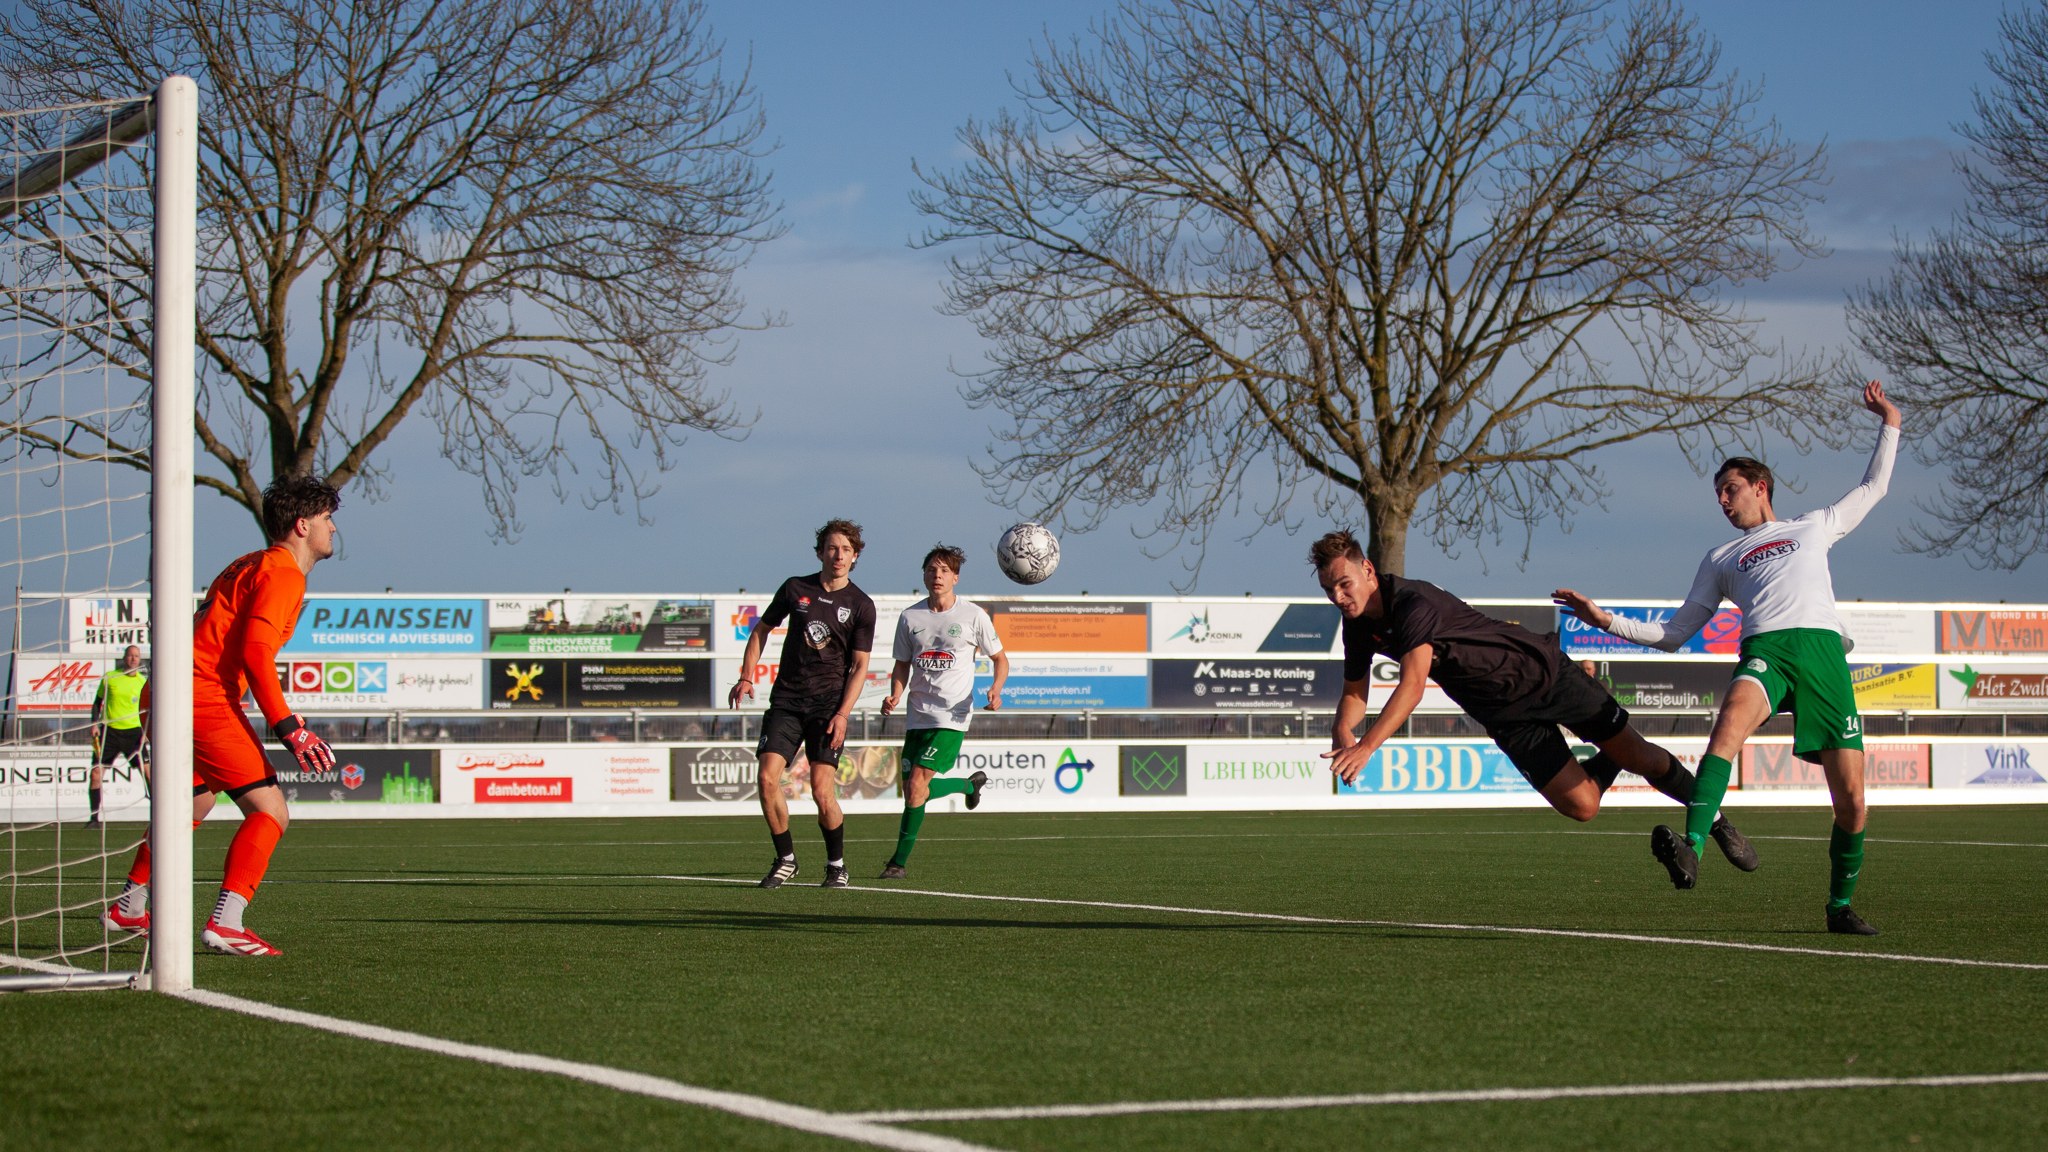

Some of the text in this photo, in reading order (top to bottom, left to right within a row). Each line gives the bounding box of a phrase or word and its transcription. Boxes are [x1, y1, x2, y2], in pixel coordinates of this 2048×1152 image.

[1740, 543, 1796, 571] ZWART
[1009, 605, 1124, 614] www.vleesbewerkingvanderpijl.nl
[1990, 611, 2021, 620] GROND
[2025, 612, 2037, 620] EN
[313, 608, 473, 629] P.JANSSEN
[312, 633, 474, 645] TECHNISCH ADVIESBURO
[528, 638, 613, 646] GRONDVERZET
[1210, 632, 1243, 640] KONIJN
[2010, 626, 2044, 648] van
[528, 645, 545, 653] EN
[548, 645, 613, 653] LOONWERK
[1608, 646, 1644, 654] Onderhoud
[582, 665, 604, 675] PHM
[916, 659, 954, 669] ZWART
[1220, 667, 1315, 681] Maas-De Koning
[1853, 676, 1896, 694] hanisatie
[1976, 675, 2006, 696] Het
[1845, 715, 1859, 732] 14
[925, 746, 938, 757] 17
[1985, 748, 2031, 769] Vink
[1203, 761, 1317, 780] LBH BOUW
[1379, 746, 1482, 792] BBD
[300, 772, 339, 783] BOUW
[986, 775, 1045, 793] energy
[50, 788, 109, 797] TECHNK
[487, 782, 562, 797] dambeton.nl
